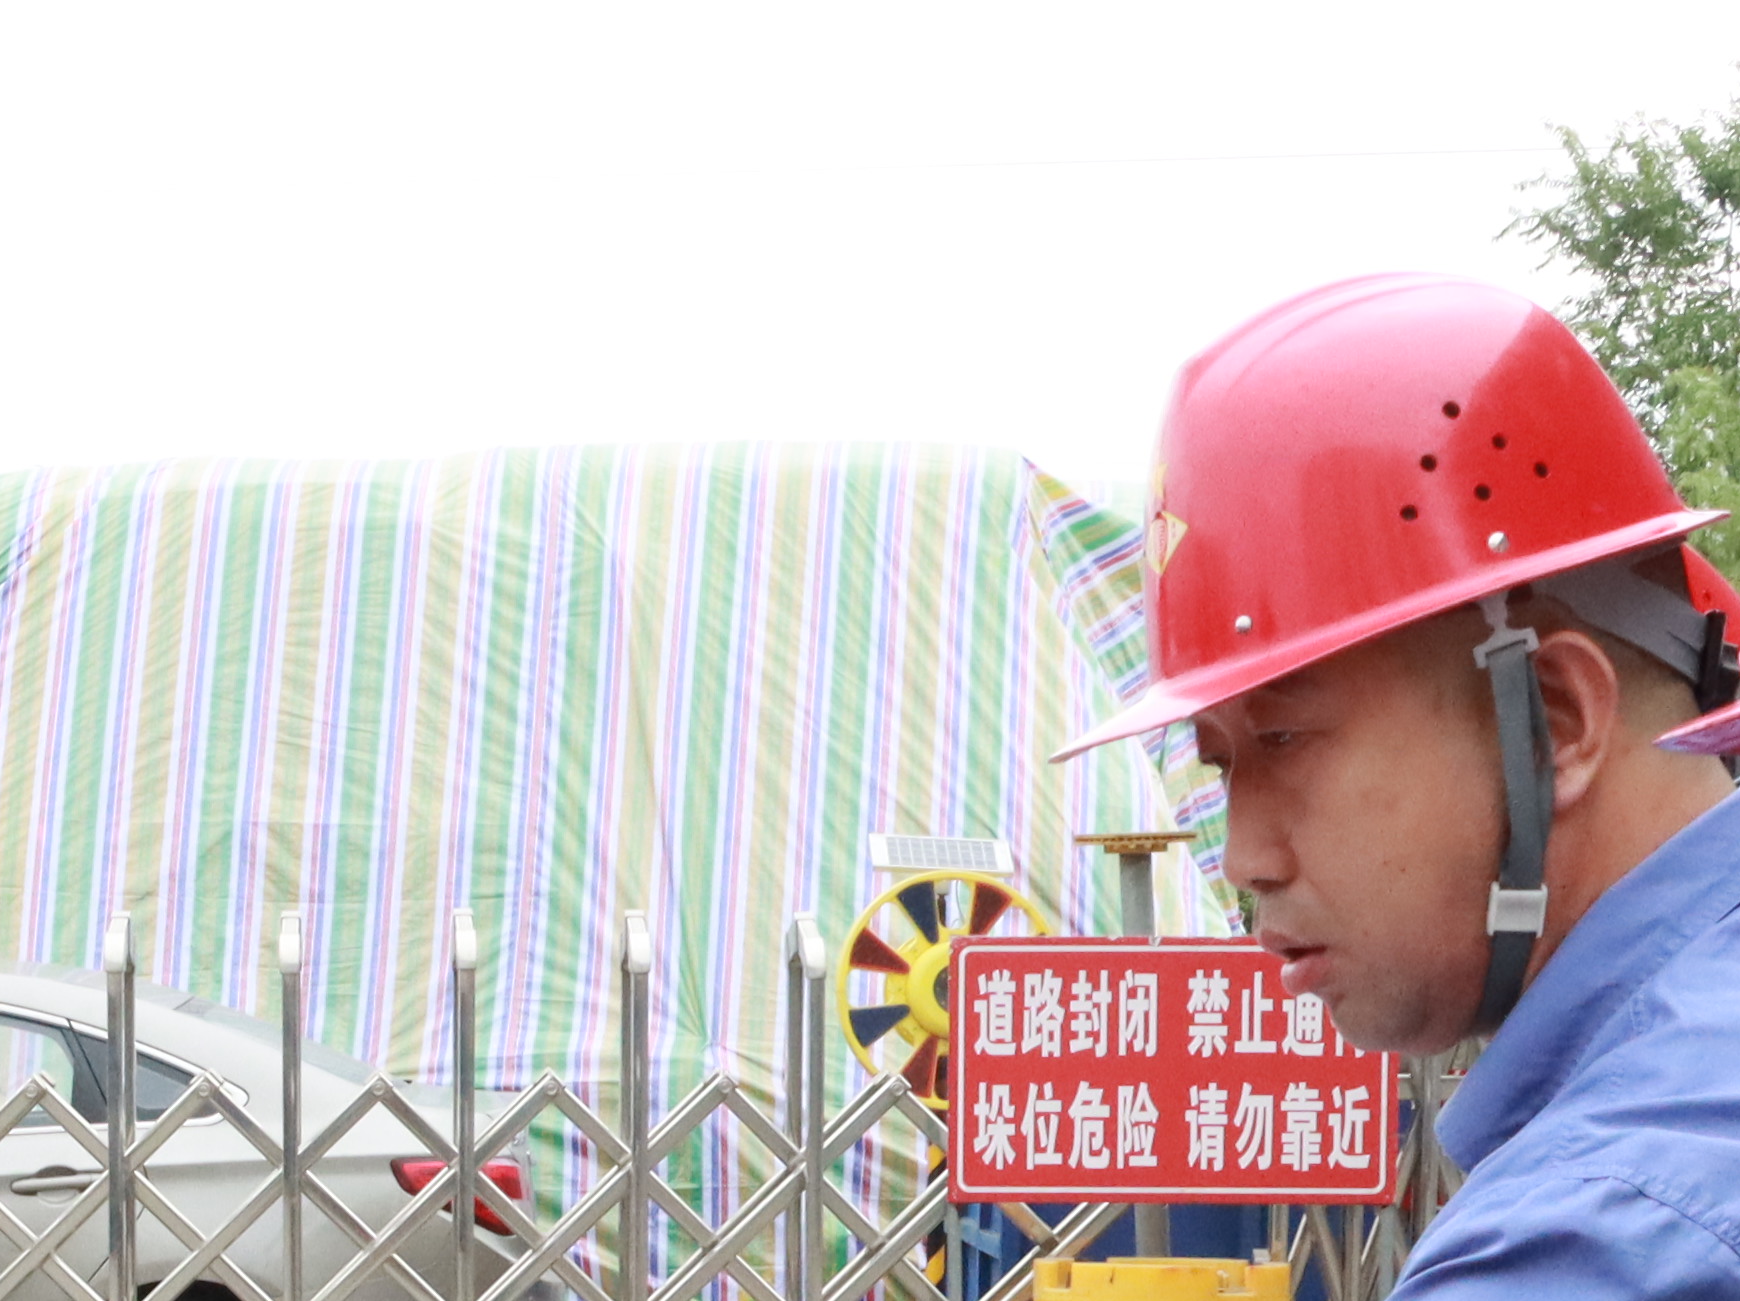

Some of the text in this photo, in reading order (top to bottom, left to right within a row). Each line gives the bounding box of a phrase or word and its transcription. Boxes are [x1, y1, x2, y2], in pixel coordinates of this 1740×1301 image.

[973, 968, 1366, 1058] 道路封闭 禁止通
[973, 1080, 1372, 1172] 垛位危险 请勿靠近
